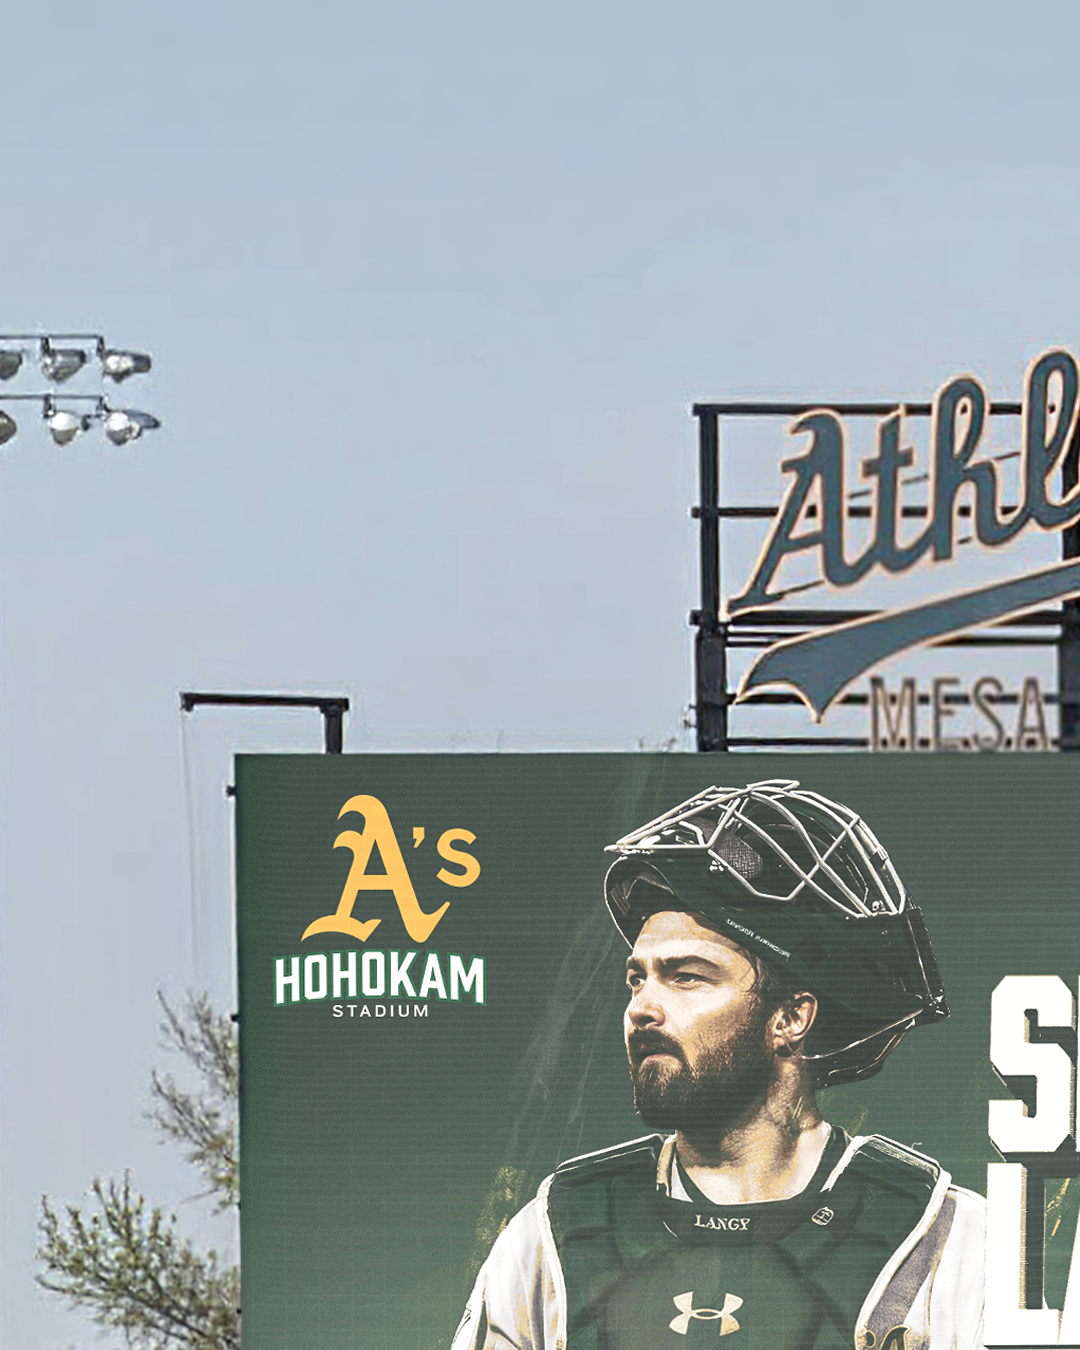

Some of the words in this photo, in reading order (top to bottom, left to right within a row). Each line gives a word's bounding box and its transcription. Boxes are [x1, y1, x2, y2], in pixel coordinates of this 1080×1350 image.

[867, 674, 1052, 753] MESA
[273, 949, 487, 1007] HOHOKAM
[332, 1004, 429, 1018] STADIUM
[693, 1214, 751, 1231] LANGY
